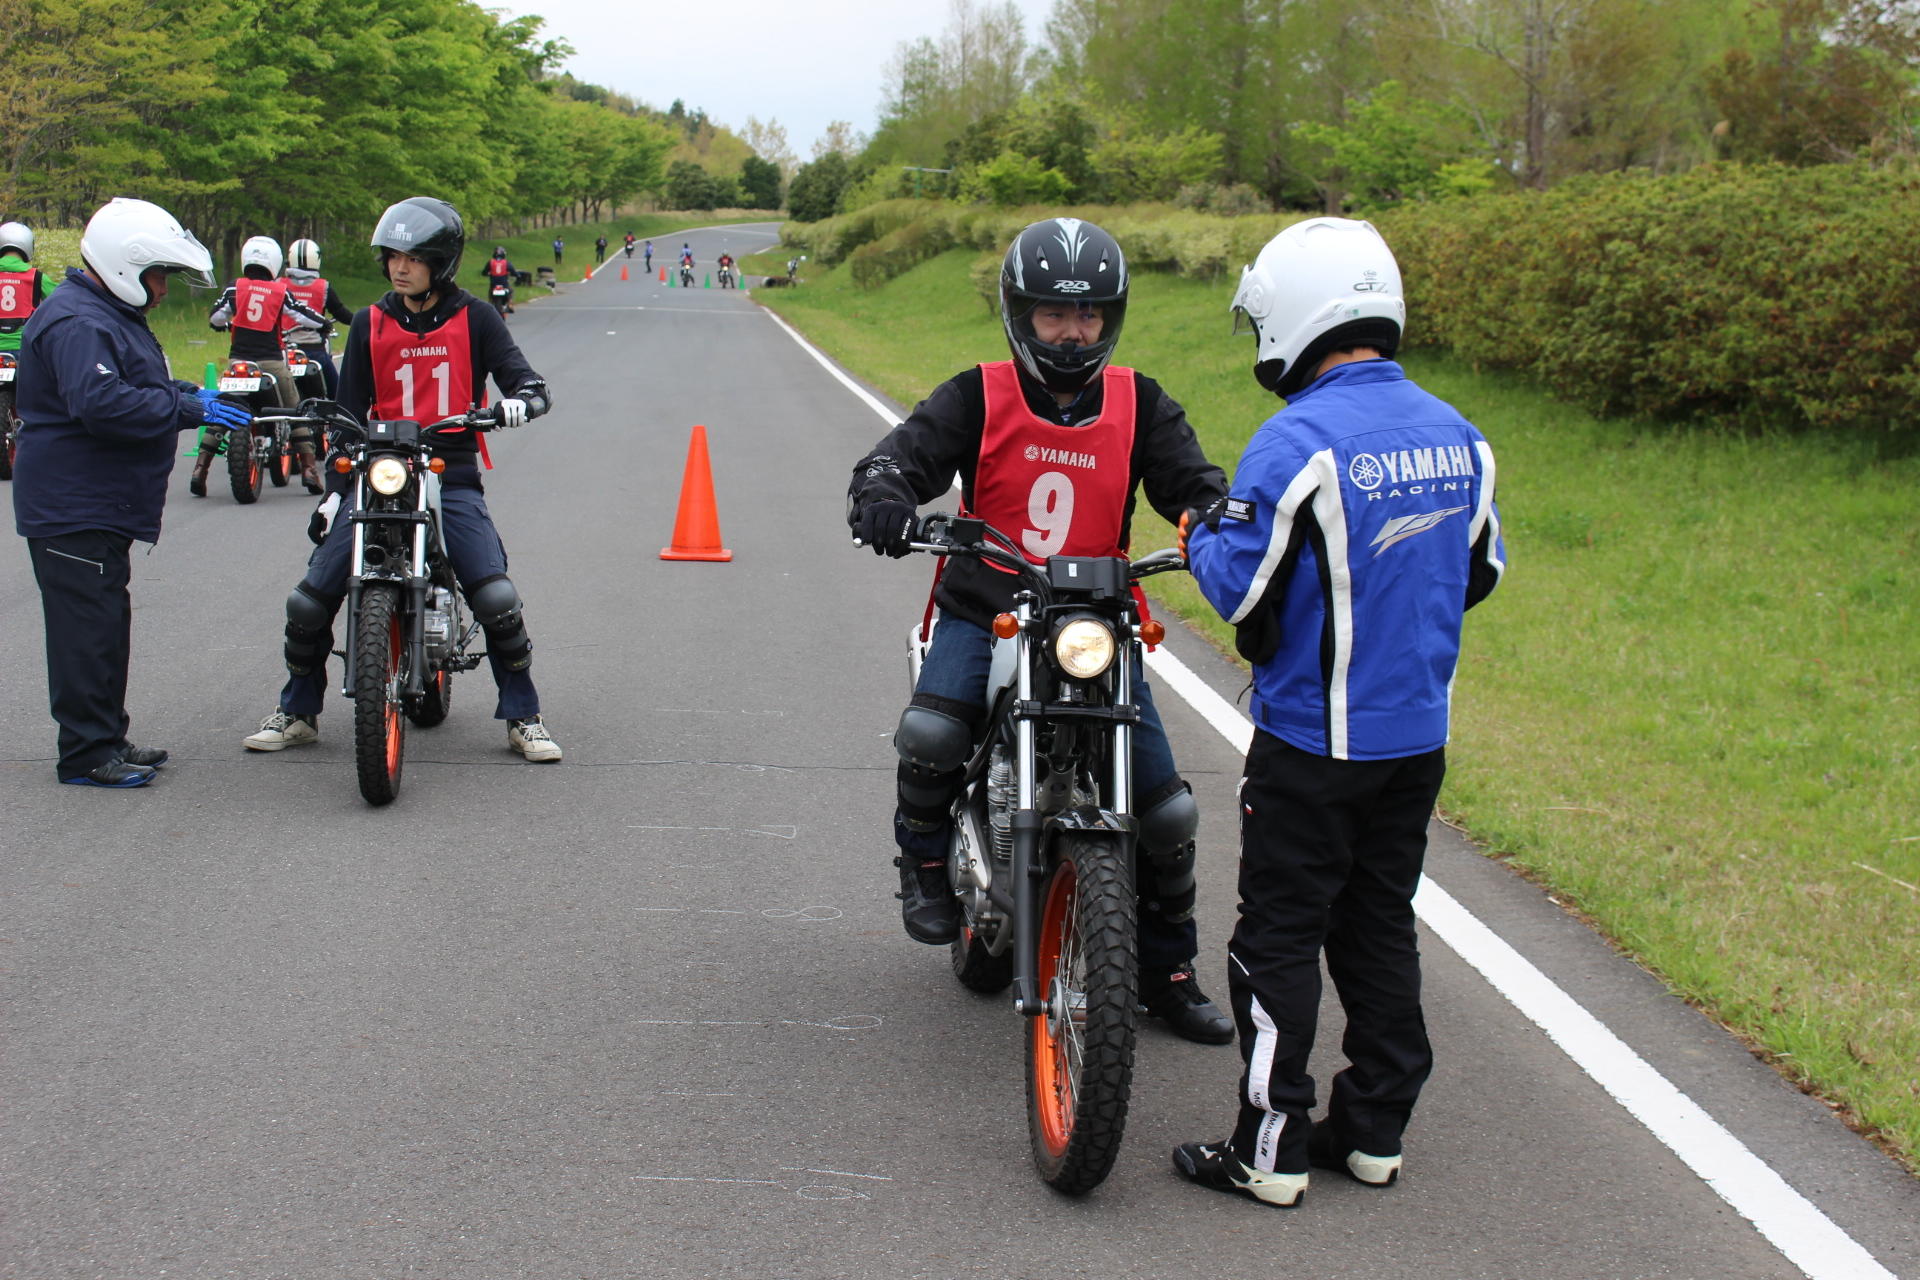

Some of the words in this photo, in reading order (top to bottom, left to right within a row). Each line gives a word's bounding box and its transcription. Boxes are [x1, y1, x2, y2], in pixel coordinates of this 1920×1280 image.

[0, 285, 17, 312] 8
[246, 293, 265, 323] 5
[410, 346, 448, 357] YAMAHA
[394, 363, 448, 416] 11
[1040, 446, 1097, 470] YAMAHA
[1368, 481, 1470, 501] RACING
[1020, 470, 1076, 560] 9
